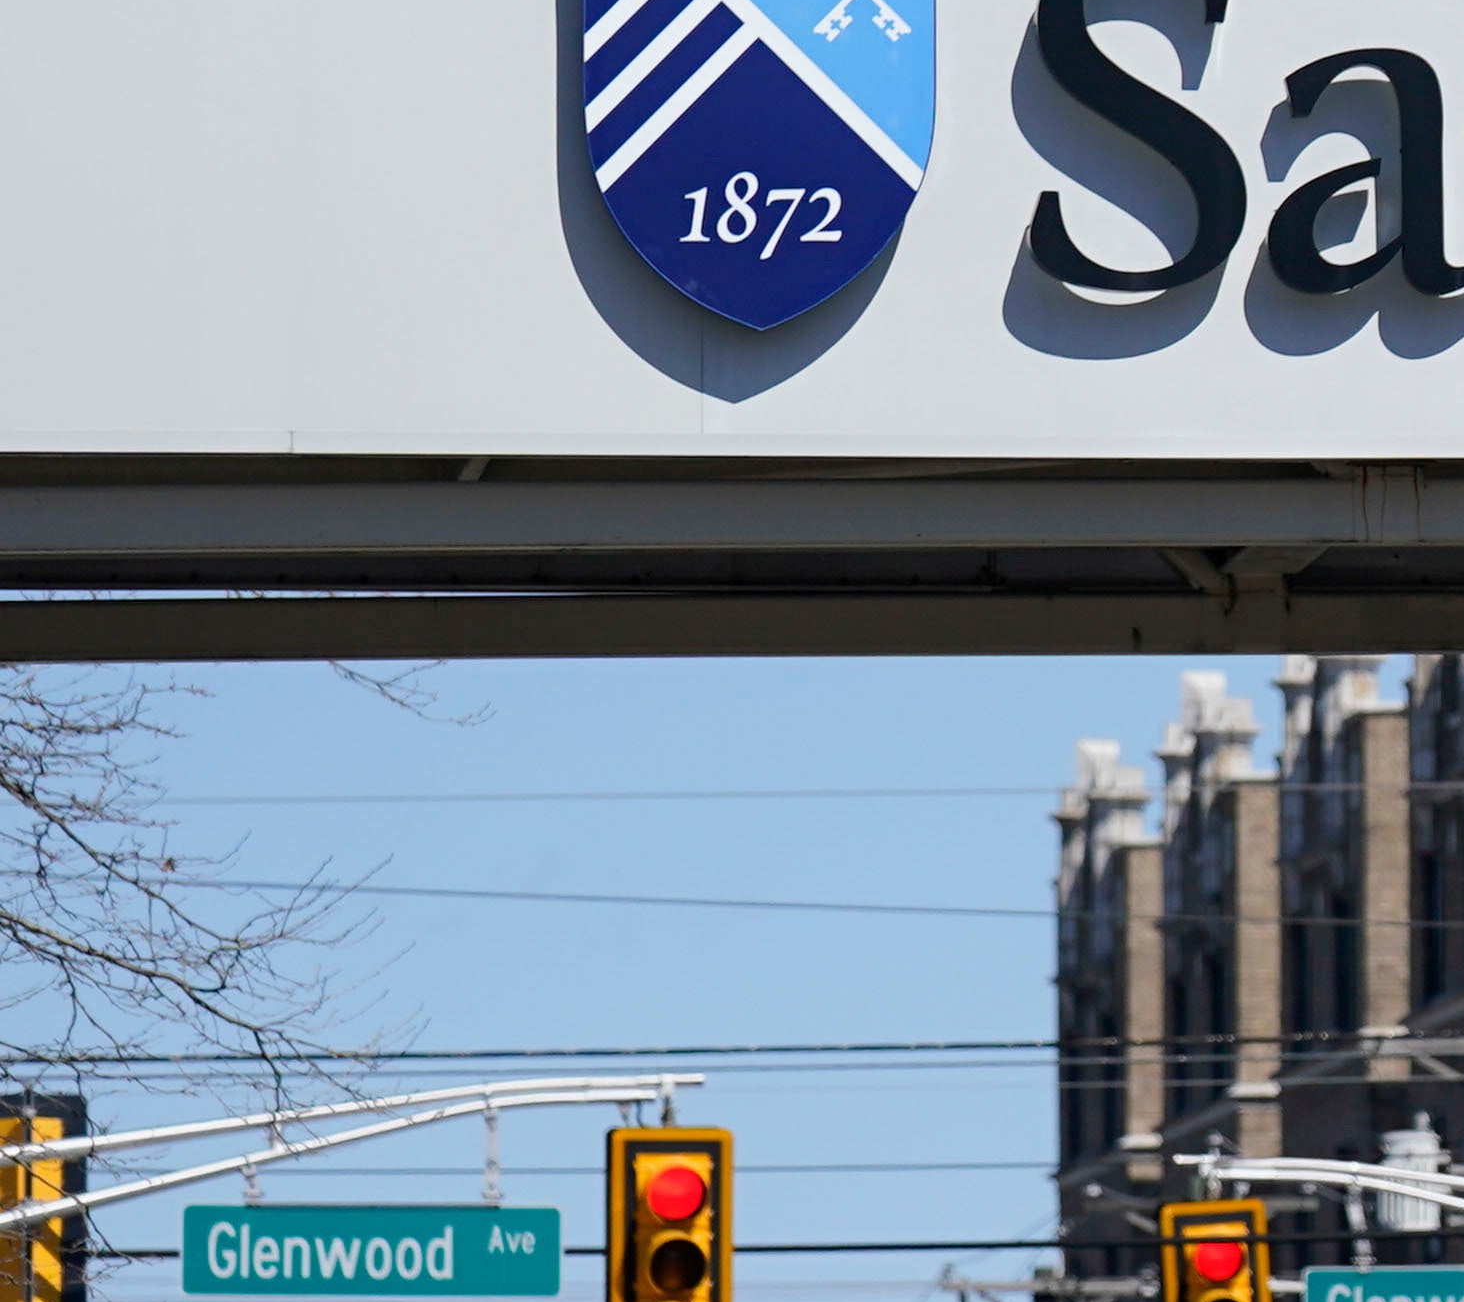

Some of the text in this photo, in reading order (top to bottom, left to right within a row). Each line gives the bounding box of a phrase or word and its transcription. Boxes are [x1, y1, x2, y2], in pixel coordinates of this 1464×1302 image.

[679, 171, 843, 260] 1872
[207, 1221, 536, 1280] Glenwood Ave
